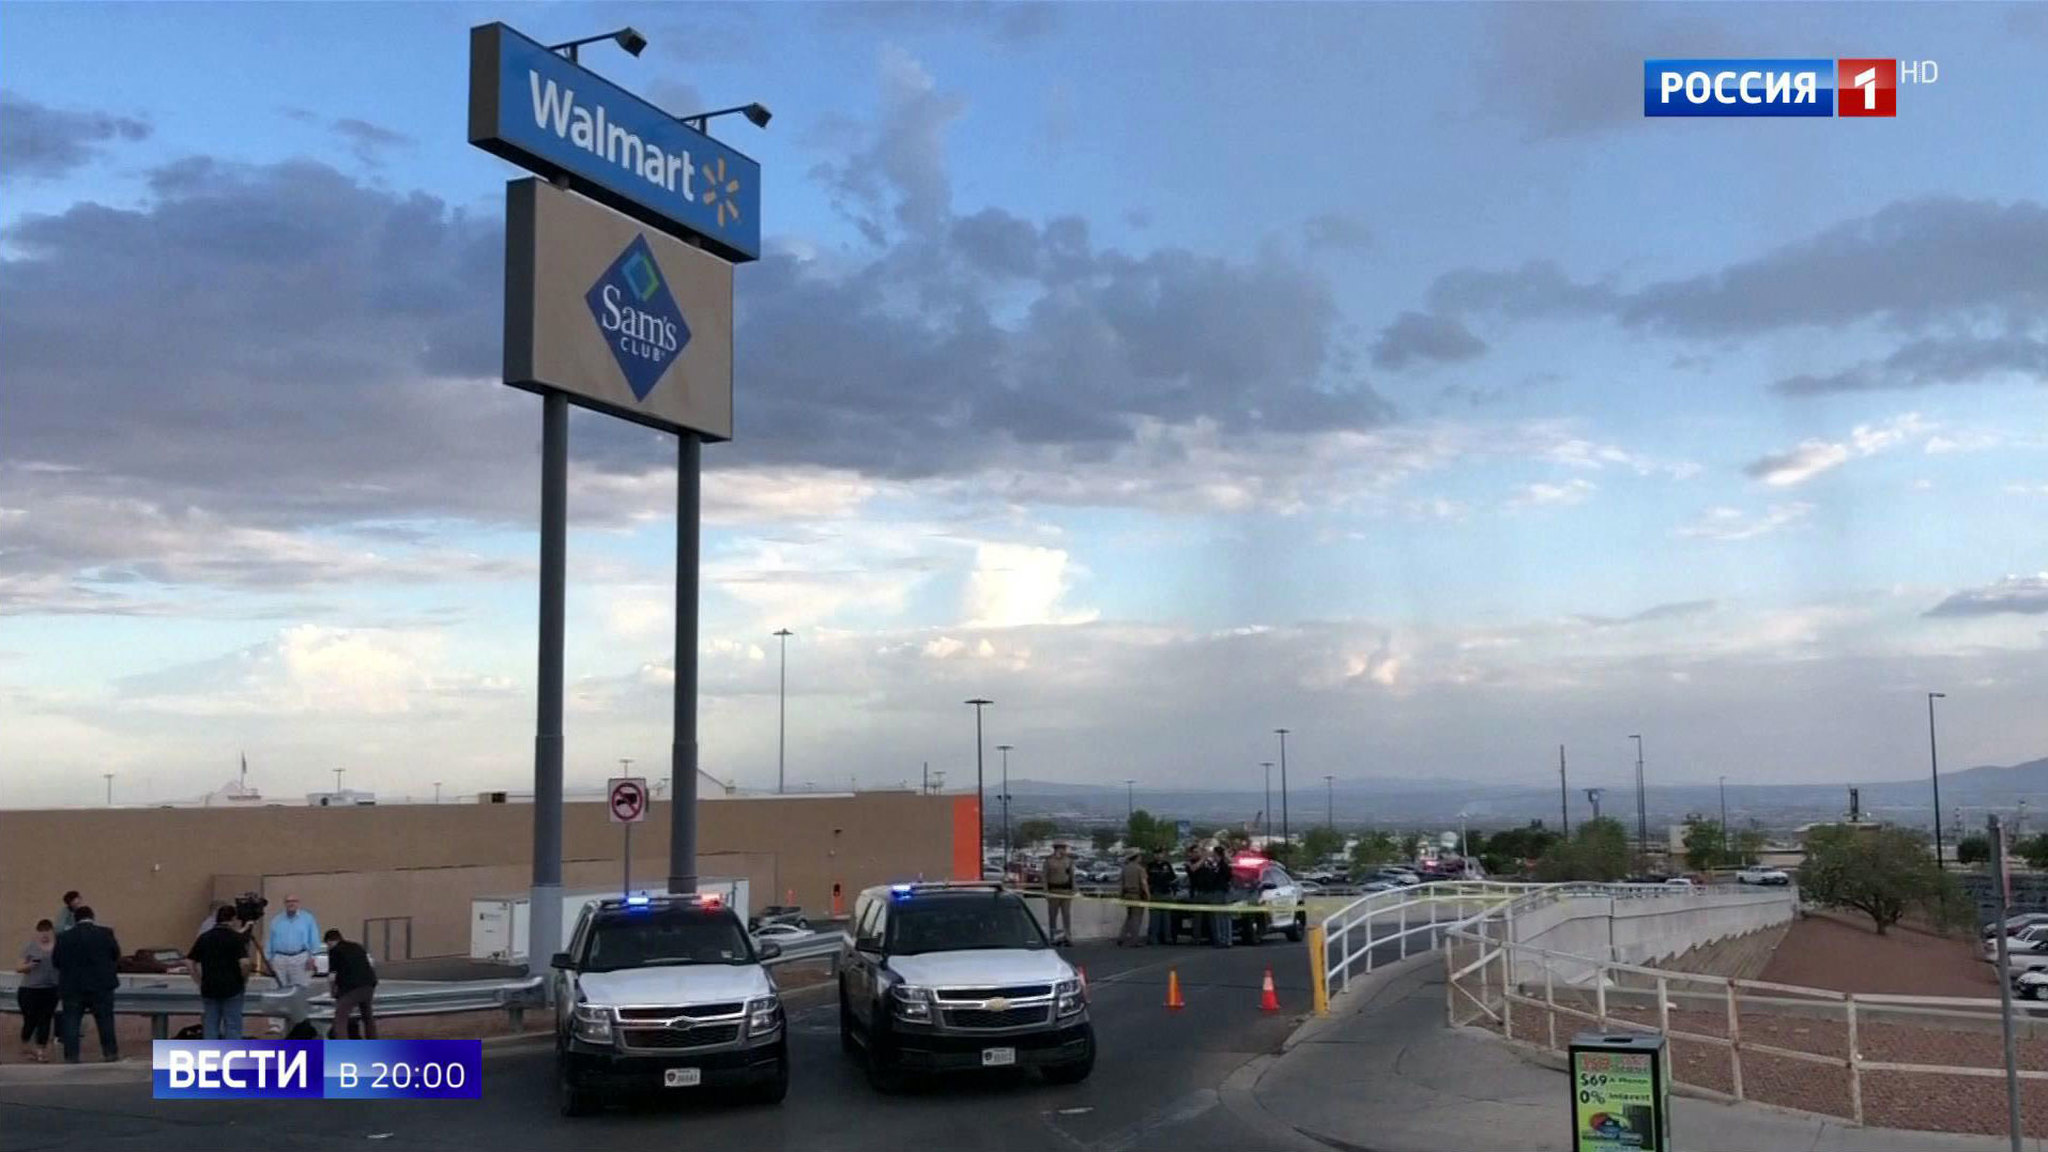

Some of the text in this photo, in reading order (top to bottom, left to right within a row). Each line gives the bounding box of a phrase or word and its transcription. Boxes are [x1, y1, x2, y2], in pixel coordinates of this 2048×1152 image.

[529, 70, 695, 202] Walmart
[602, 284, 677, 352] Sam's
[1580, 1090, 1606, 1104] 0%
